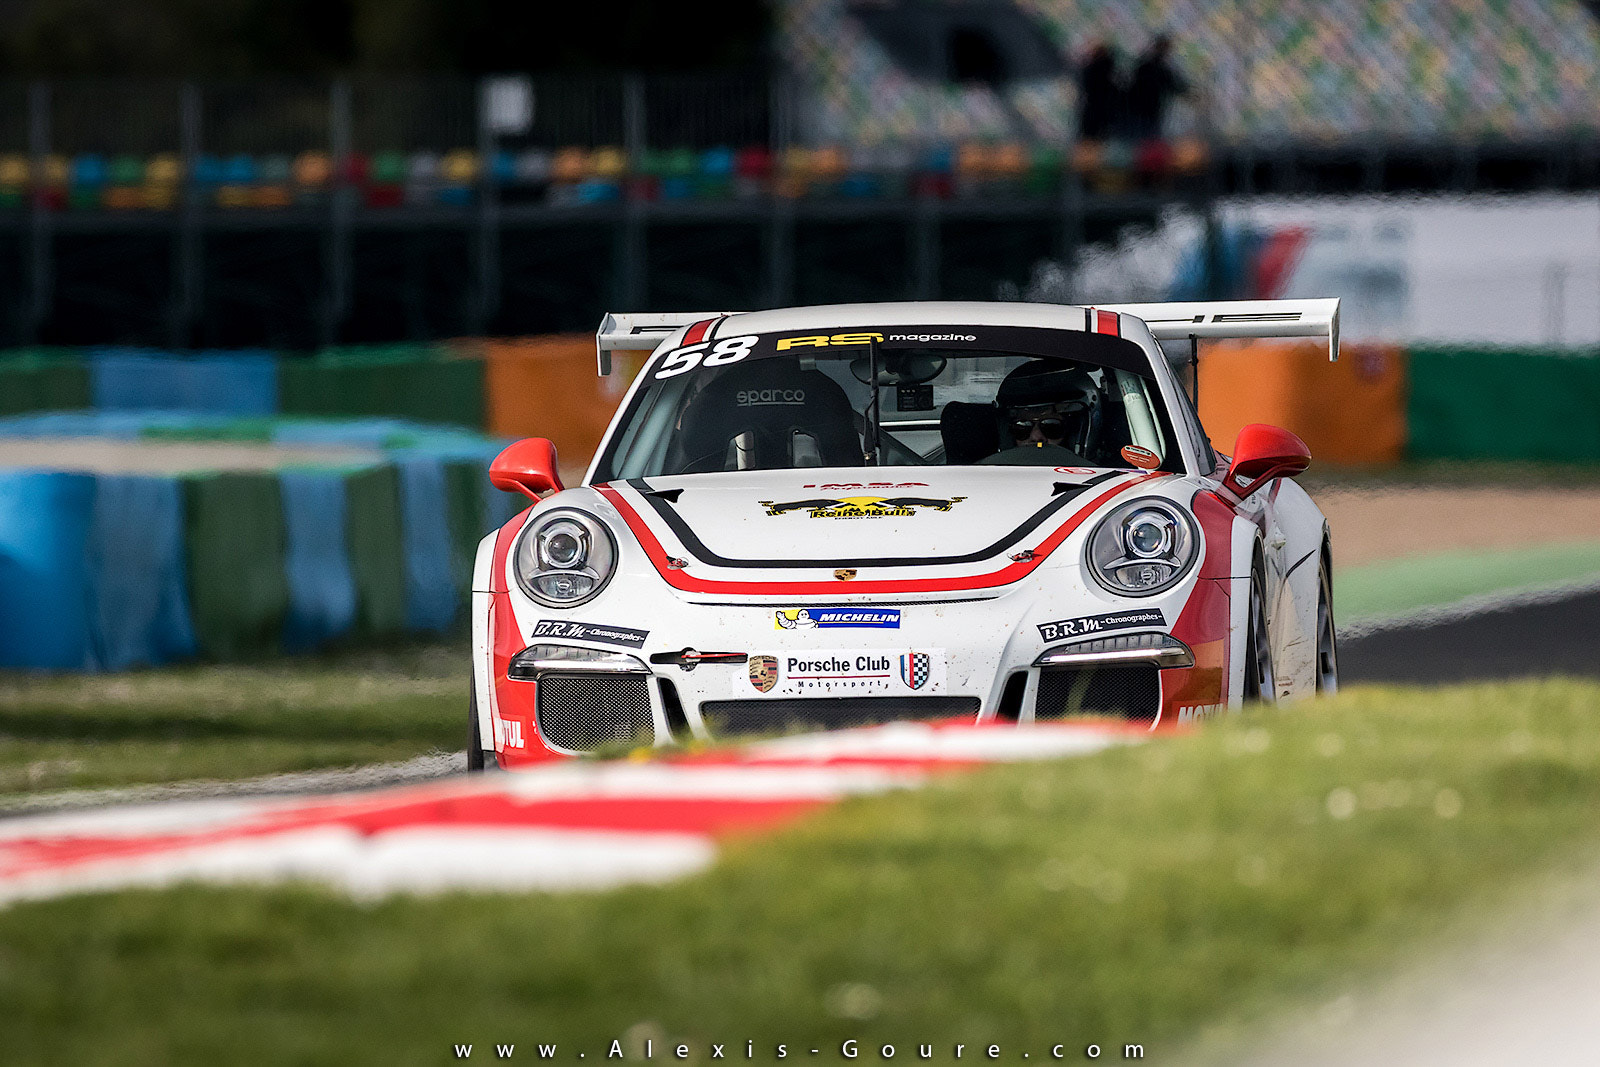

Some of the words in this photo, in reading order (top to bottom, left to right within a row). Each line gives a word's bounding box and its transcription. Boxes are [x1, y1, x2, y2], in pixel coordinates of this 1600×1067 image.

[776, 332, 884, 351] RS
[889, 333, 977, 343] magazine
[654, 335, 760, 380] 58
[736, 388, 806, 404] sparco
[819, 613, 900, 623] MICHELIN
[787, 657, 851, 672] Porsche
[855, 656, 891, 671] Club
[797, 681, 882, 689] Motorsport
